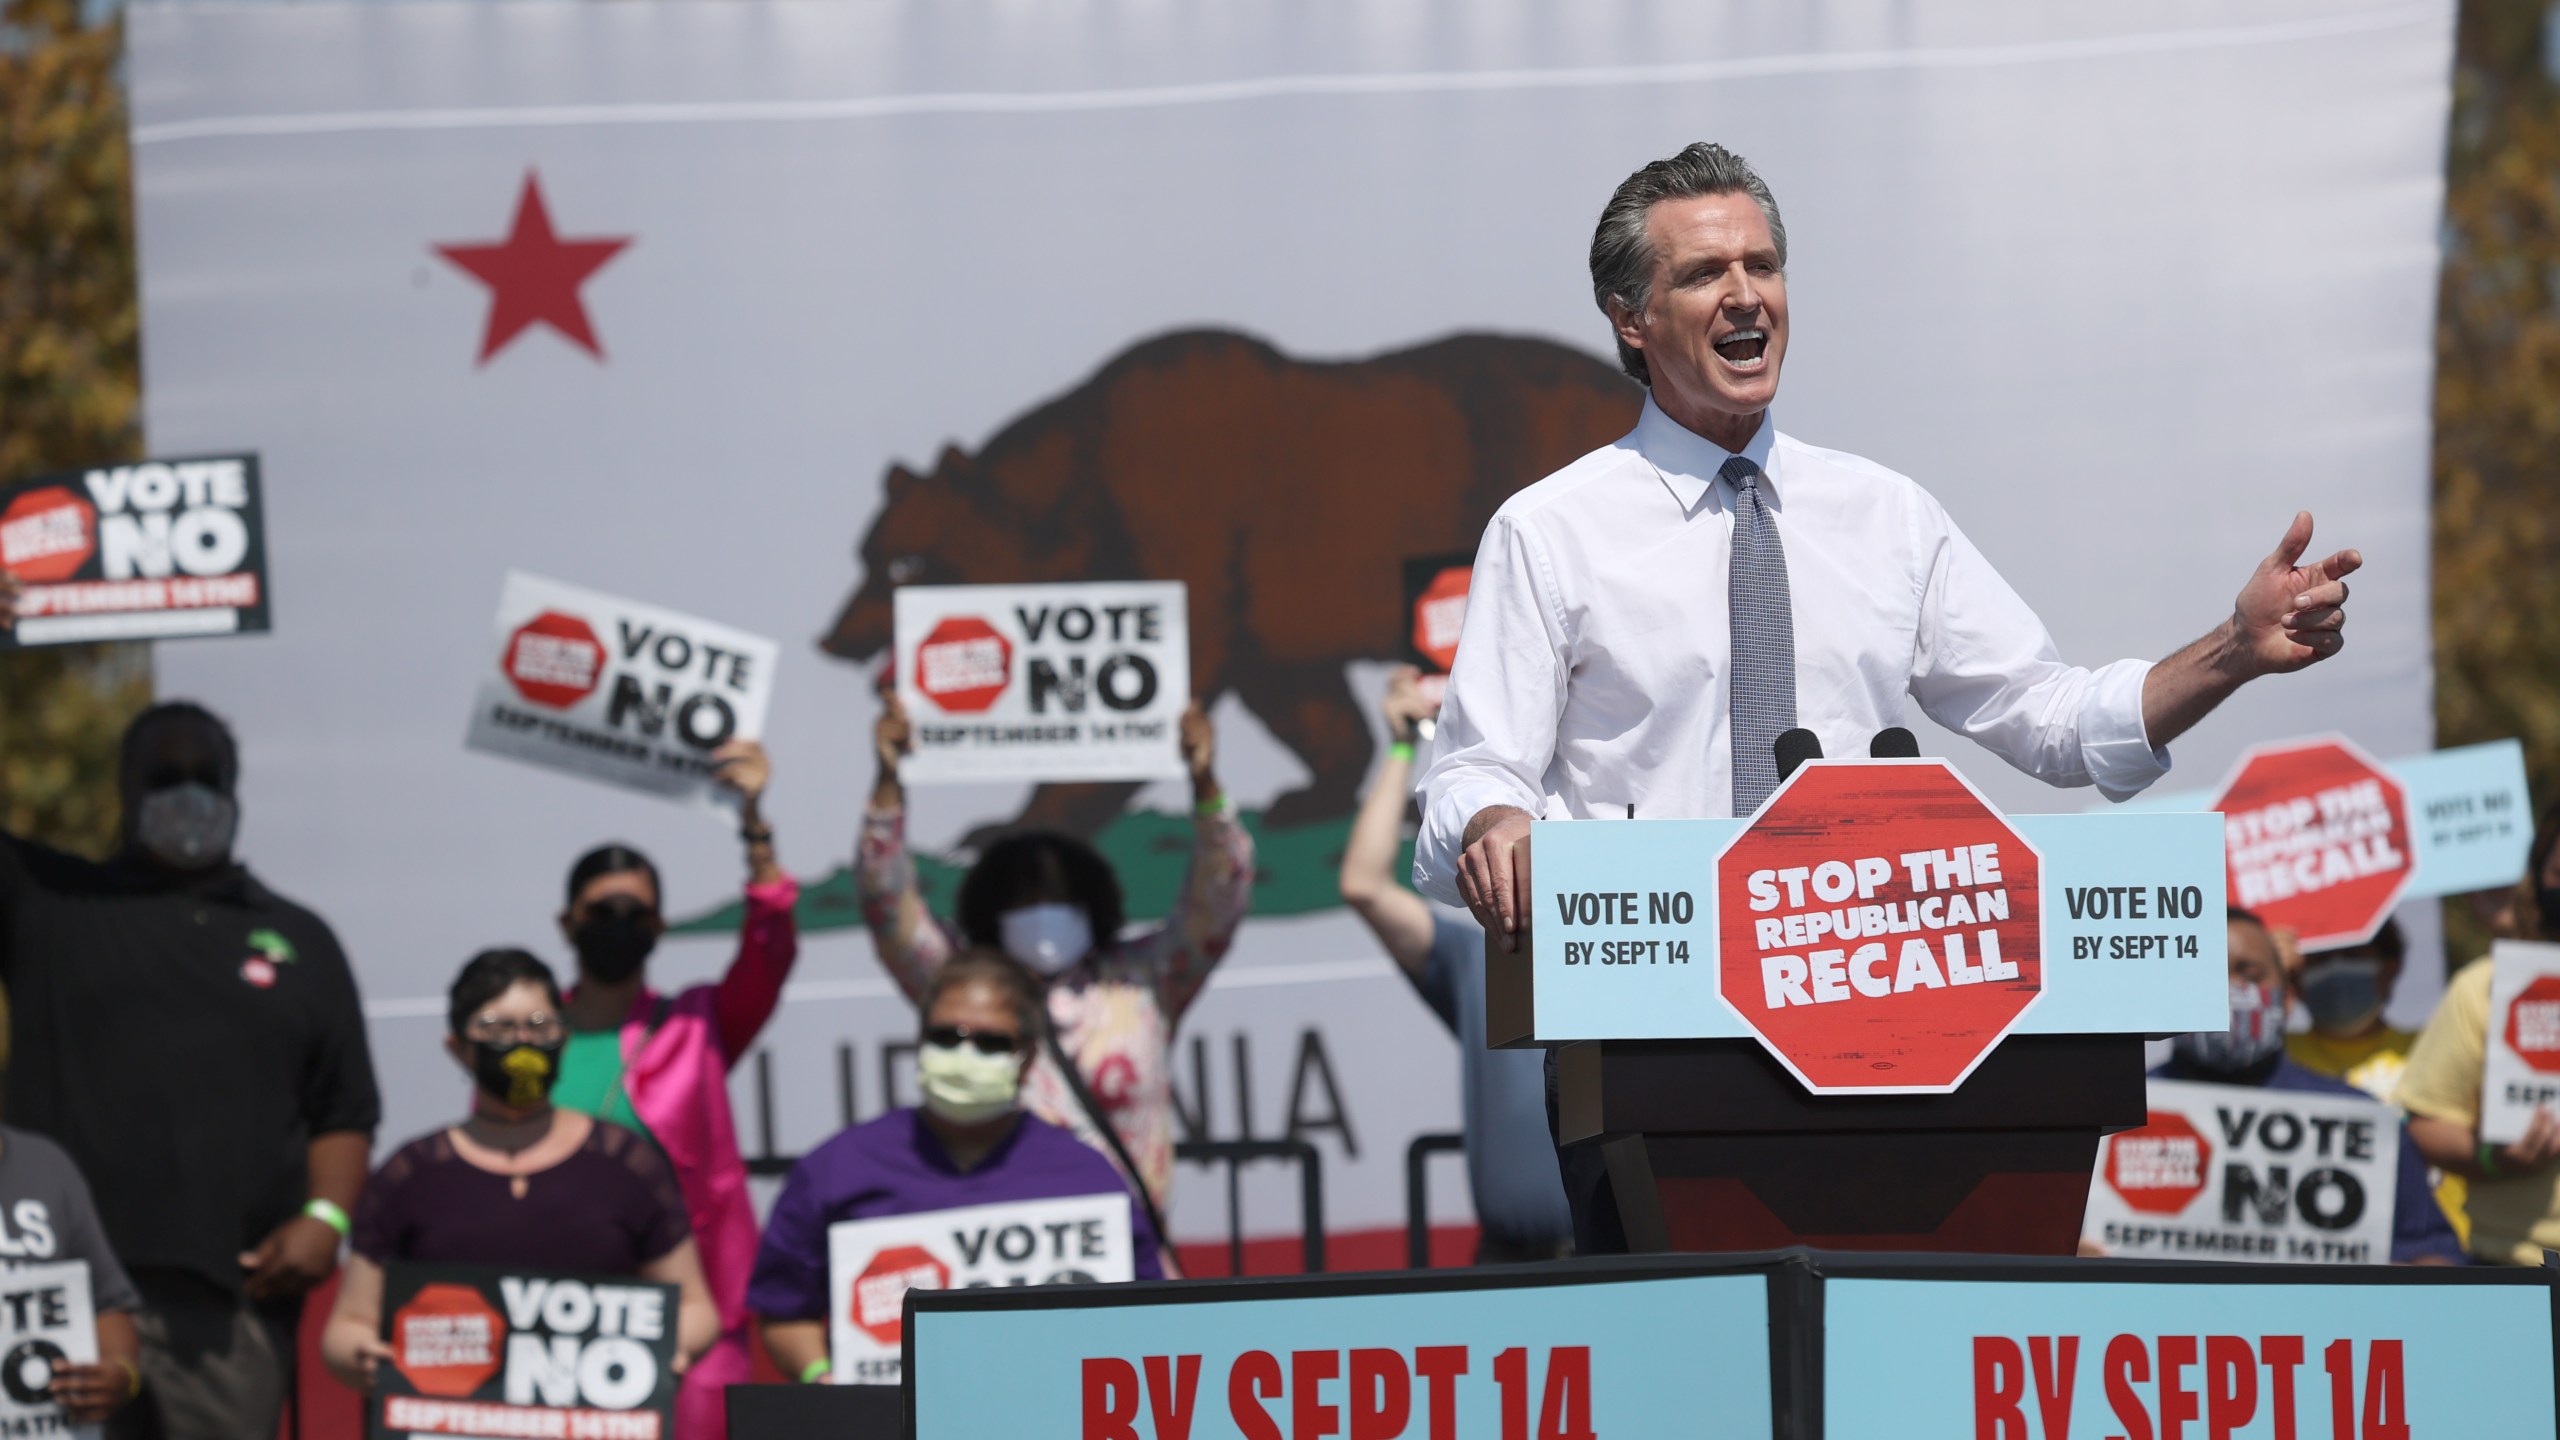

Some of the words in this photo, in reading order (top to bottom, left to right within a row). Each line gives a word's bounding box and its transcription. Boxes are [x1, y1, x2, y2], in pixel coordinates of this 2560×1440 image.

[84, 459, 249, 513] VOTE
[101, 504, 249, 580] NO
[17, 578, 166, 615] EPTEMBER
[1015, 603, 1162, 643] VOTE
[617, 617, 753, 692] VOTE
[1029, 650, 1158, 715] NO
[490, 702, 649, 762] SEPTEMBER
[606, 670, 737, 751] NO
[921, 723, 1080, 745] SEPTEMBER
[2225, 796, 2315, 848] STOP
[2315, 777, 2384, 813] THE
[1747, 857, 1893, 912] STOP
[1900, 843, 2003, 893] THE
[2064, 886, 2148, 920] VOTE
[2157, 885, 2203, 919] NO
[2237, 835, 2404, 909] RECALL
[1556, 892, 1639, 926] VOTE
[1649, 891, 1694, 925] NO
[1755, 889, 2010, 951] REPUBLICAN
[1564, 942, 1595, 966] BY
[1601, 941, 1660, 966] SEPT
[1666, 940, 1690, 964] 14
[1760, 929, 2020, 1010] RECALL
[2073, 936, 2103, 960] BY
[2109, 935, 2169, 960] SEPT
[2175, 935, 2199, 959] 14
[2216, 1107, 2375, 1160] VOTE
[2221, 1164, 2366, 1231] NO
[953, 1220, 1105, 1266] VOTE
[2105, 1222, 2278, 1258] SEPTEMBER
[2287, 1237, 2369, 1264] 14TH!
[0, 1287, 68, 1331] TE
[501, 1275, 667, 1341] VOTE
[505, 1332, 658, 1411] NO
[1082, 1353, 1203, 1440] BY
[1228, 1345, 1468, 1440] SEPT
[1493, 1345, 1598, 1440] 14
[1972, 1335, 2080, 1440] BY
[2103, 1333, 2305, 1440] SEPT
[2324, 1338, 2411, 1440] 14
[386, 1398, 566, 1437] SEPTEMBER
[570, 1410, 661, 1440] 14TH!
